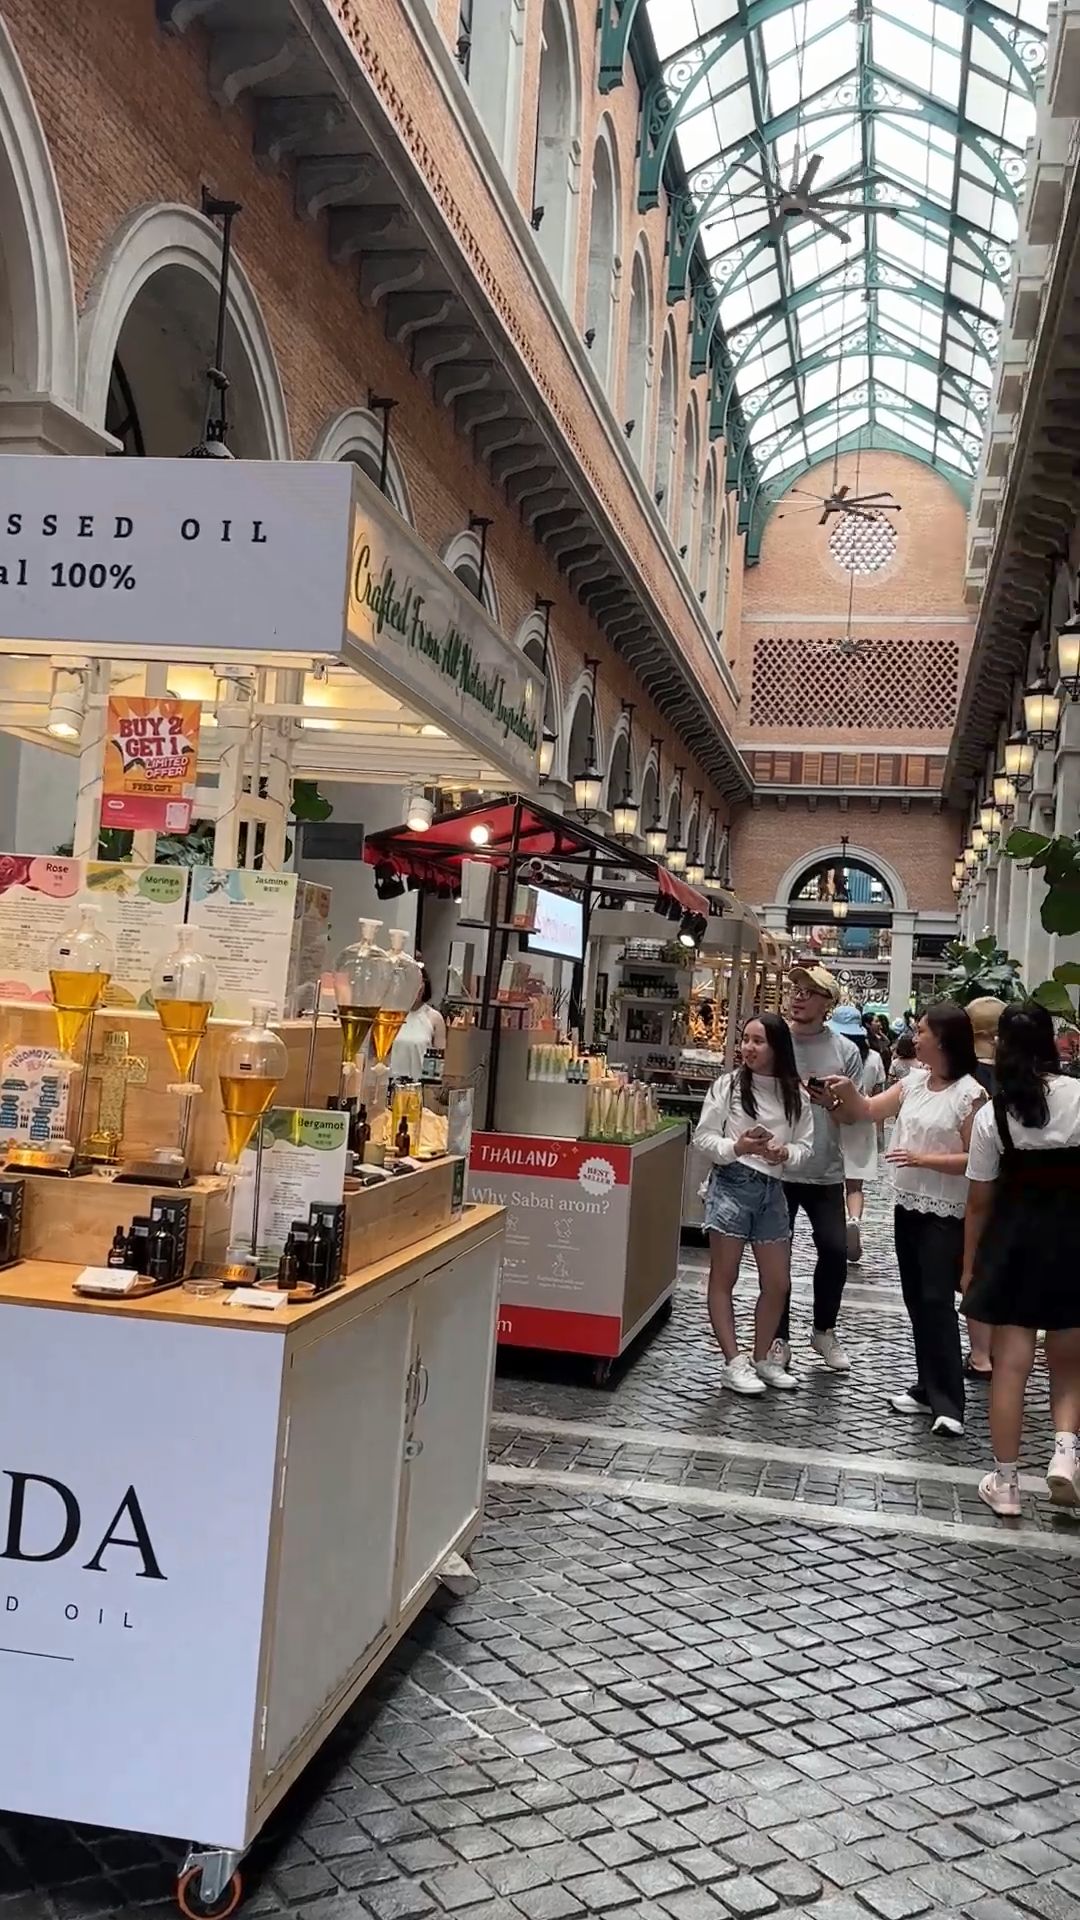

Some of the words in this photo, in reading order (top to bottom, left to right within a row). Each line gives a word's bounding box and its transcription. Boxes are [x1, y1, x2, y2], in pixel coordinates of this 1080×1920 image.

[7, 513, 134, 538] SSED
[180, 518, 267, 543] OIL
[51, 562, 136, 590] 100%
[354, 545, 412, 634] Crafted
[410, 596, 440, 665] From
[497, 678, 538, 751] Ingredients
[119, 717, 163, 738] BUY
[168, 716, 183, 736] 2
[125, 737, 166, 757] GET
[170, 736, 179, 756] 1
[146, 756, 189, 769] LIMITED
[132, 783, 153, 792] FREE
[154, 784, 173, 792] GIFT
[46, 863, 69, 873] Rose
[145, 876, 180, 886] Moringa
[255, 876, 288, 886] Jasmine
[837, 968, 878, 988] One
[297, 1117, 345, 1130] Bergamot
[481, 1145, 559, 1168] THAILAND
[583, 1174, 611, 1185] SELLER
[587, 1167, 609, 1178] BEST
[471, 1187, 507, 1206] Why
[511, 1191, 555, 1210] Sabai
[558, 1199, 610, 1215] arom?
[0, 1470, 168, 1580] DA
[6, 1596, 19, 1612] D
[64, 1603, 134, 1629] OIL
